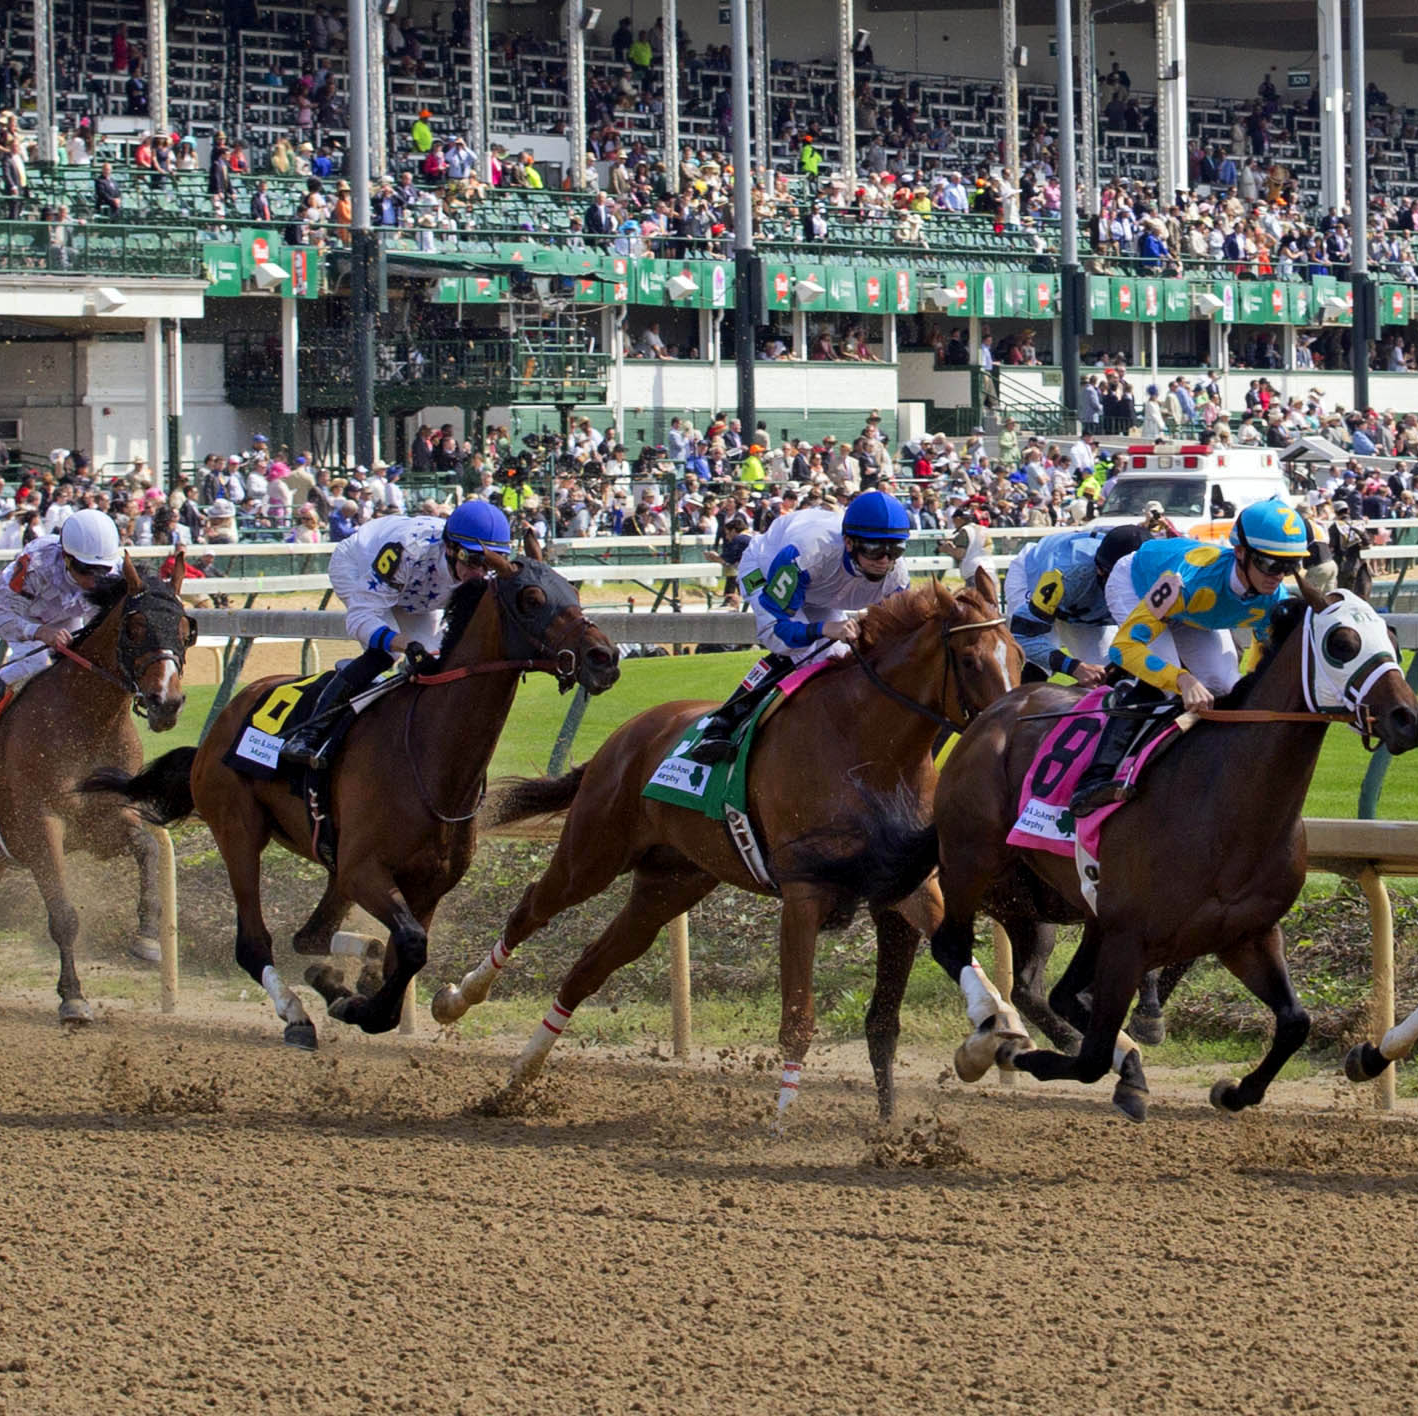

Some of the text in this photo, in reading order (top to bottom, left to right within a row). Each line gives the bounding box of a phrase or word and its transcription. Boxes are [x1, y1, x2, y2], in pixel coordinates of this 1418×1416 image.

[377, 548, 398, 574] 6
[772, 570, 793, 600] 5
[1039, 582, 1057, 605] 4
[1150, 582, 1172, 608] 8
[1031, 716, 1102, 798] 8
